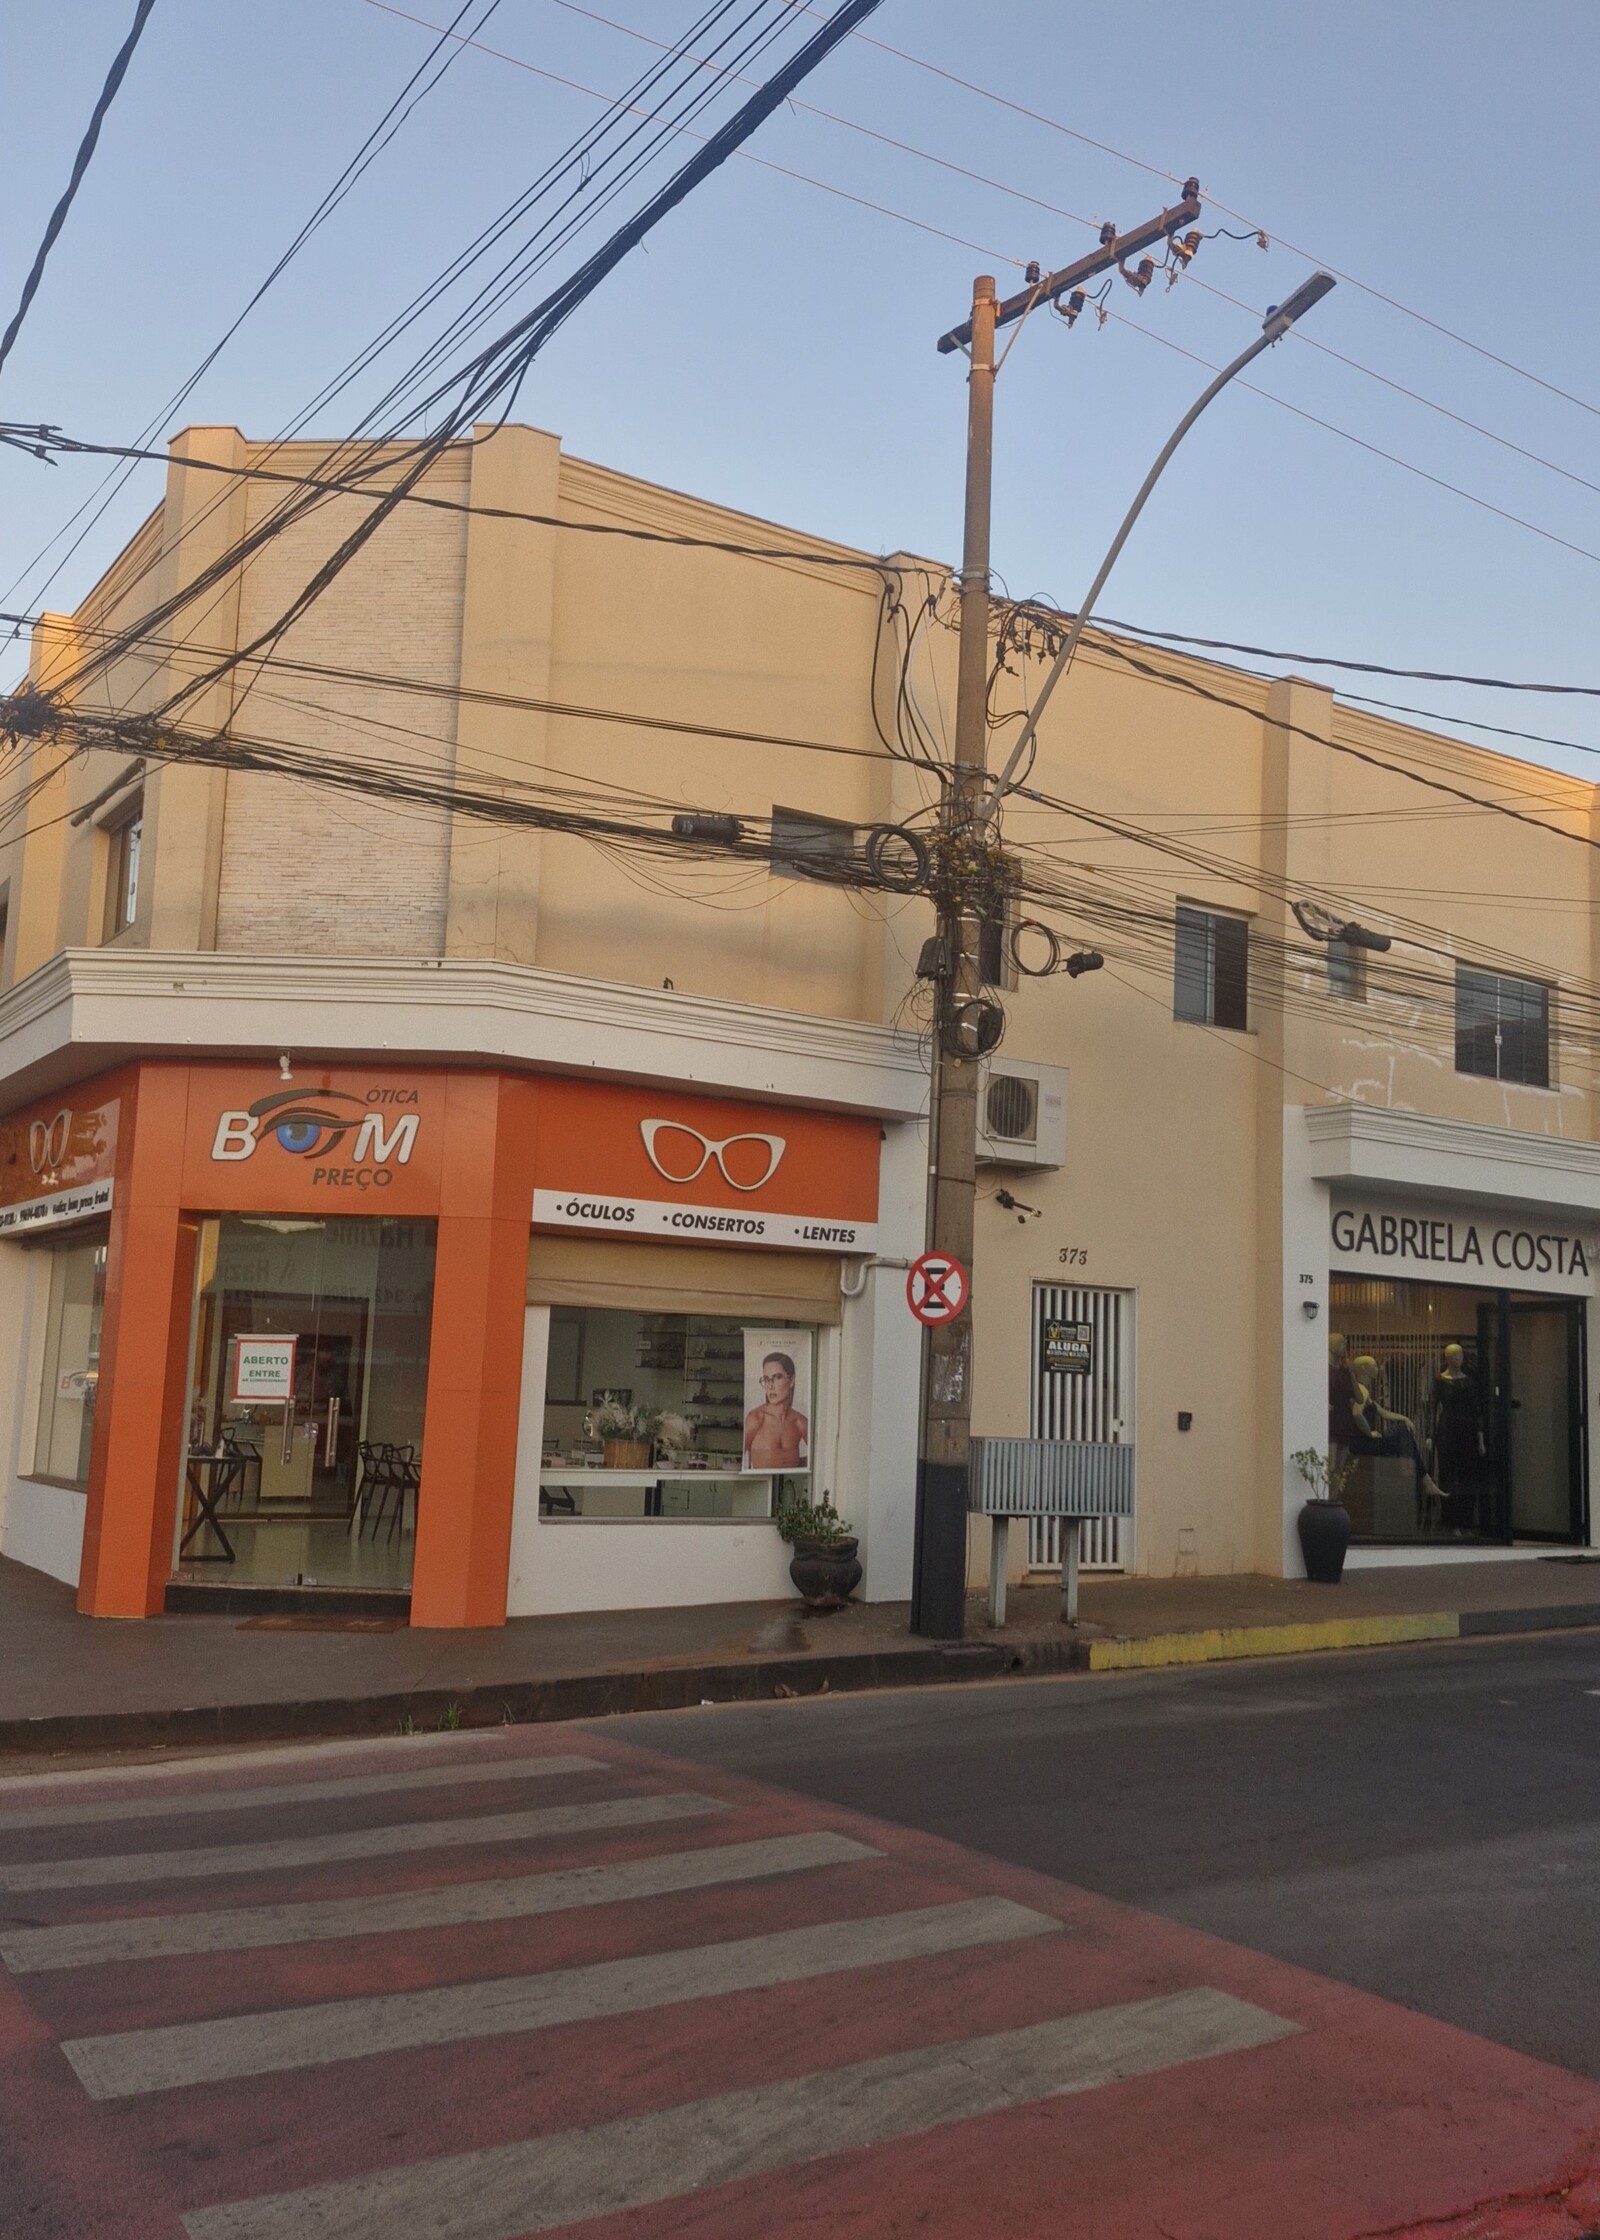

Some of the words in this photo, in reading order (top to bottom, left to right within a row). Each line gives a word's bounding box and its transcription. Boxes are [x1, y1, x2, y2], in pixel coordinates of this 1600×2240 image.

[366, 1086, 419, 1104] ÓTICA
[312, 1167, 393, 1191] PREÇO
[565, 1198, 635, 1222] ÓCULOS
[671, 1212, 765, 1235] CONSERTOS
[803, 1226, 856, 1244] LENTES
[1331, 1210, 1484, 1266] GABRIELA
[1492, 1229, 1589, 1277] COSTA
[1059, 1247, 1088, 1265] 373
[1299, 1274, 1314, 1284] 375
[1048, 1341, 1088, 1352] ALUGA
[243, 1356, 288, 1365] ABERTO
